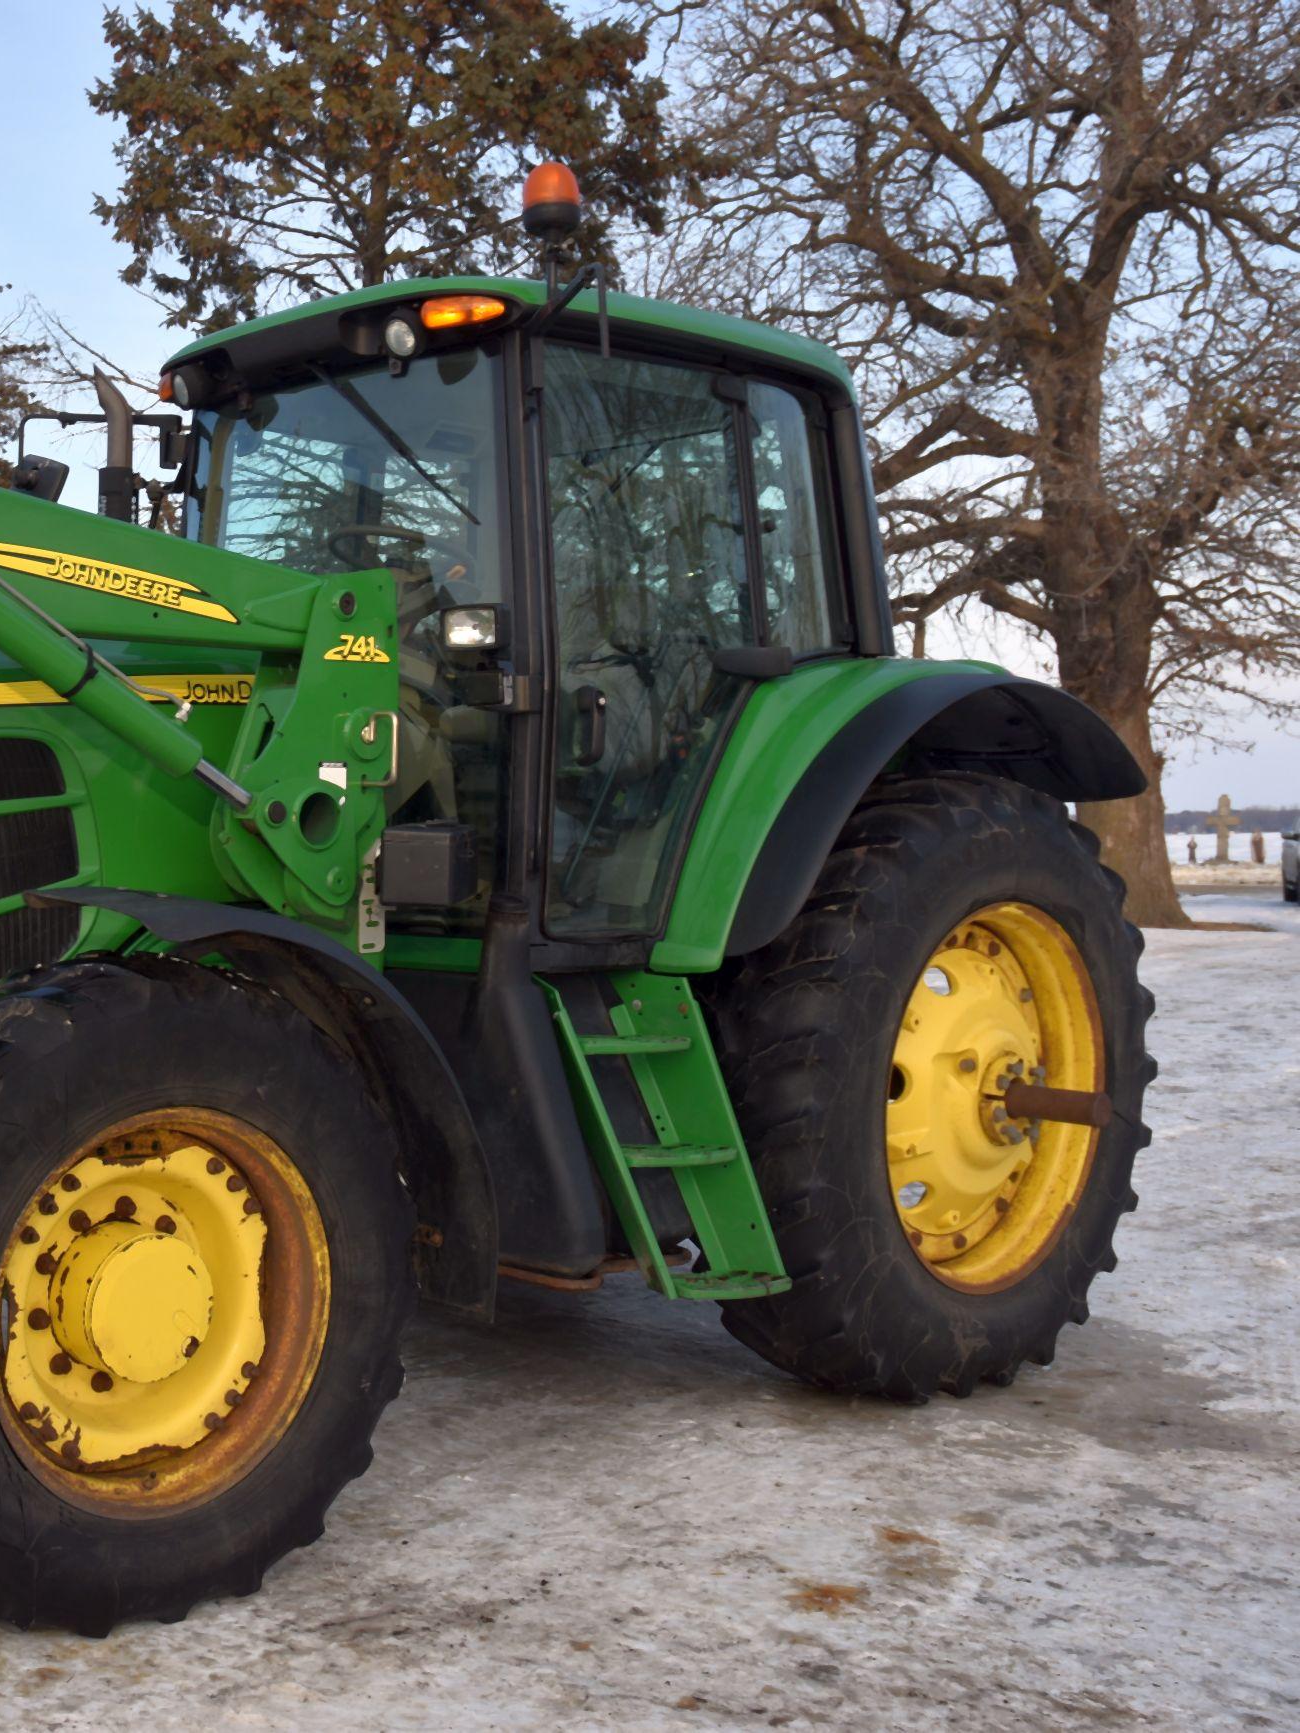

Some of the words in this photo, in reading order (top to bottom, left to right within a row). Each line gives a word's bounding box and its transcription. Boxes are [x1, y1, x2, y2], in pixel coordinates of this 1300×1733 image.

[46, 556, 106, 588] JOHN
[107, 568, 181, 606] DEERE
[340, 634, 375, 657] 741
[182, 680, 235, 700] JOHN
